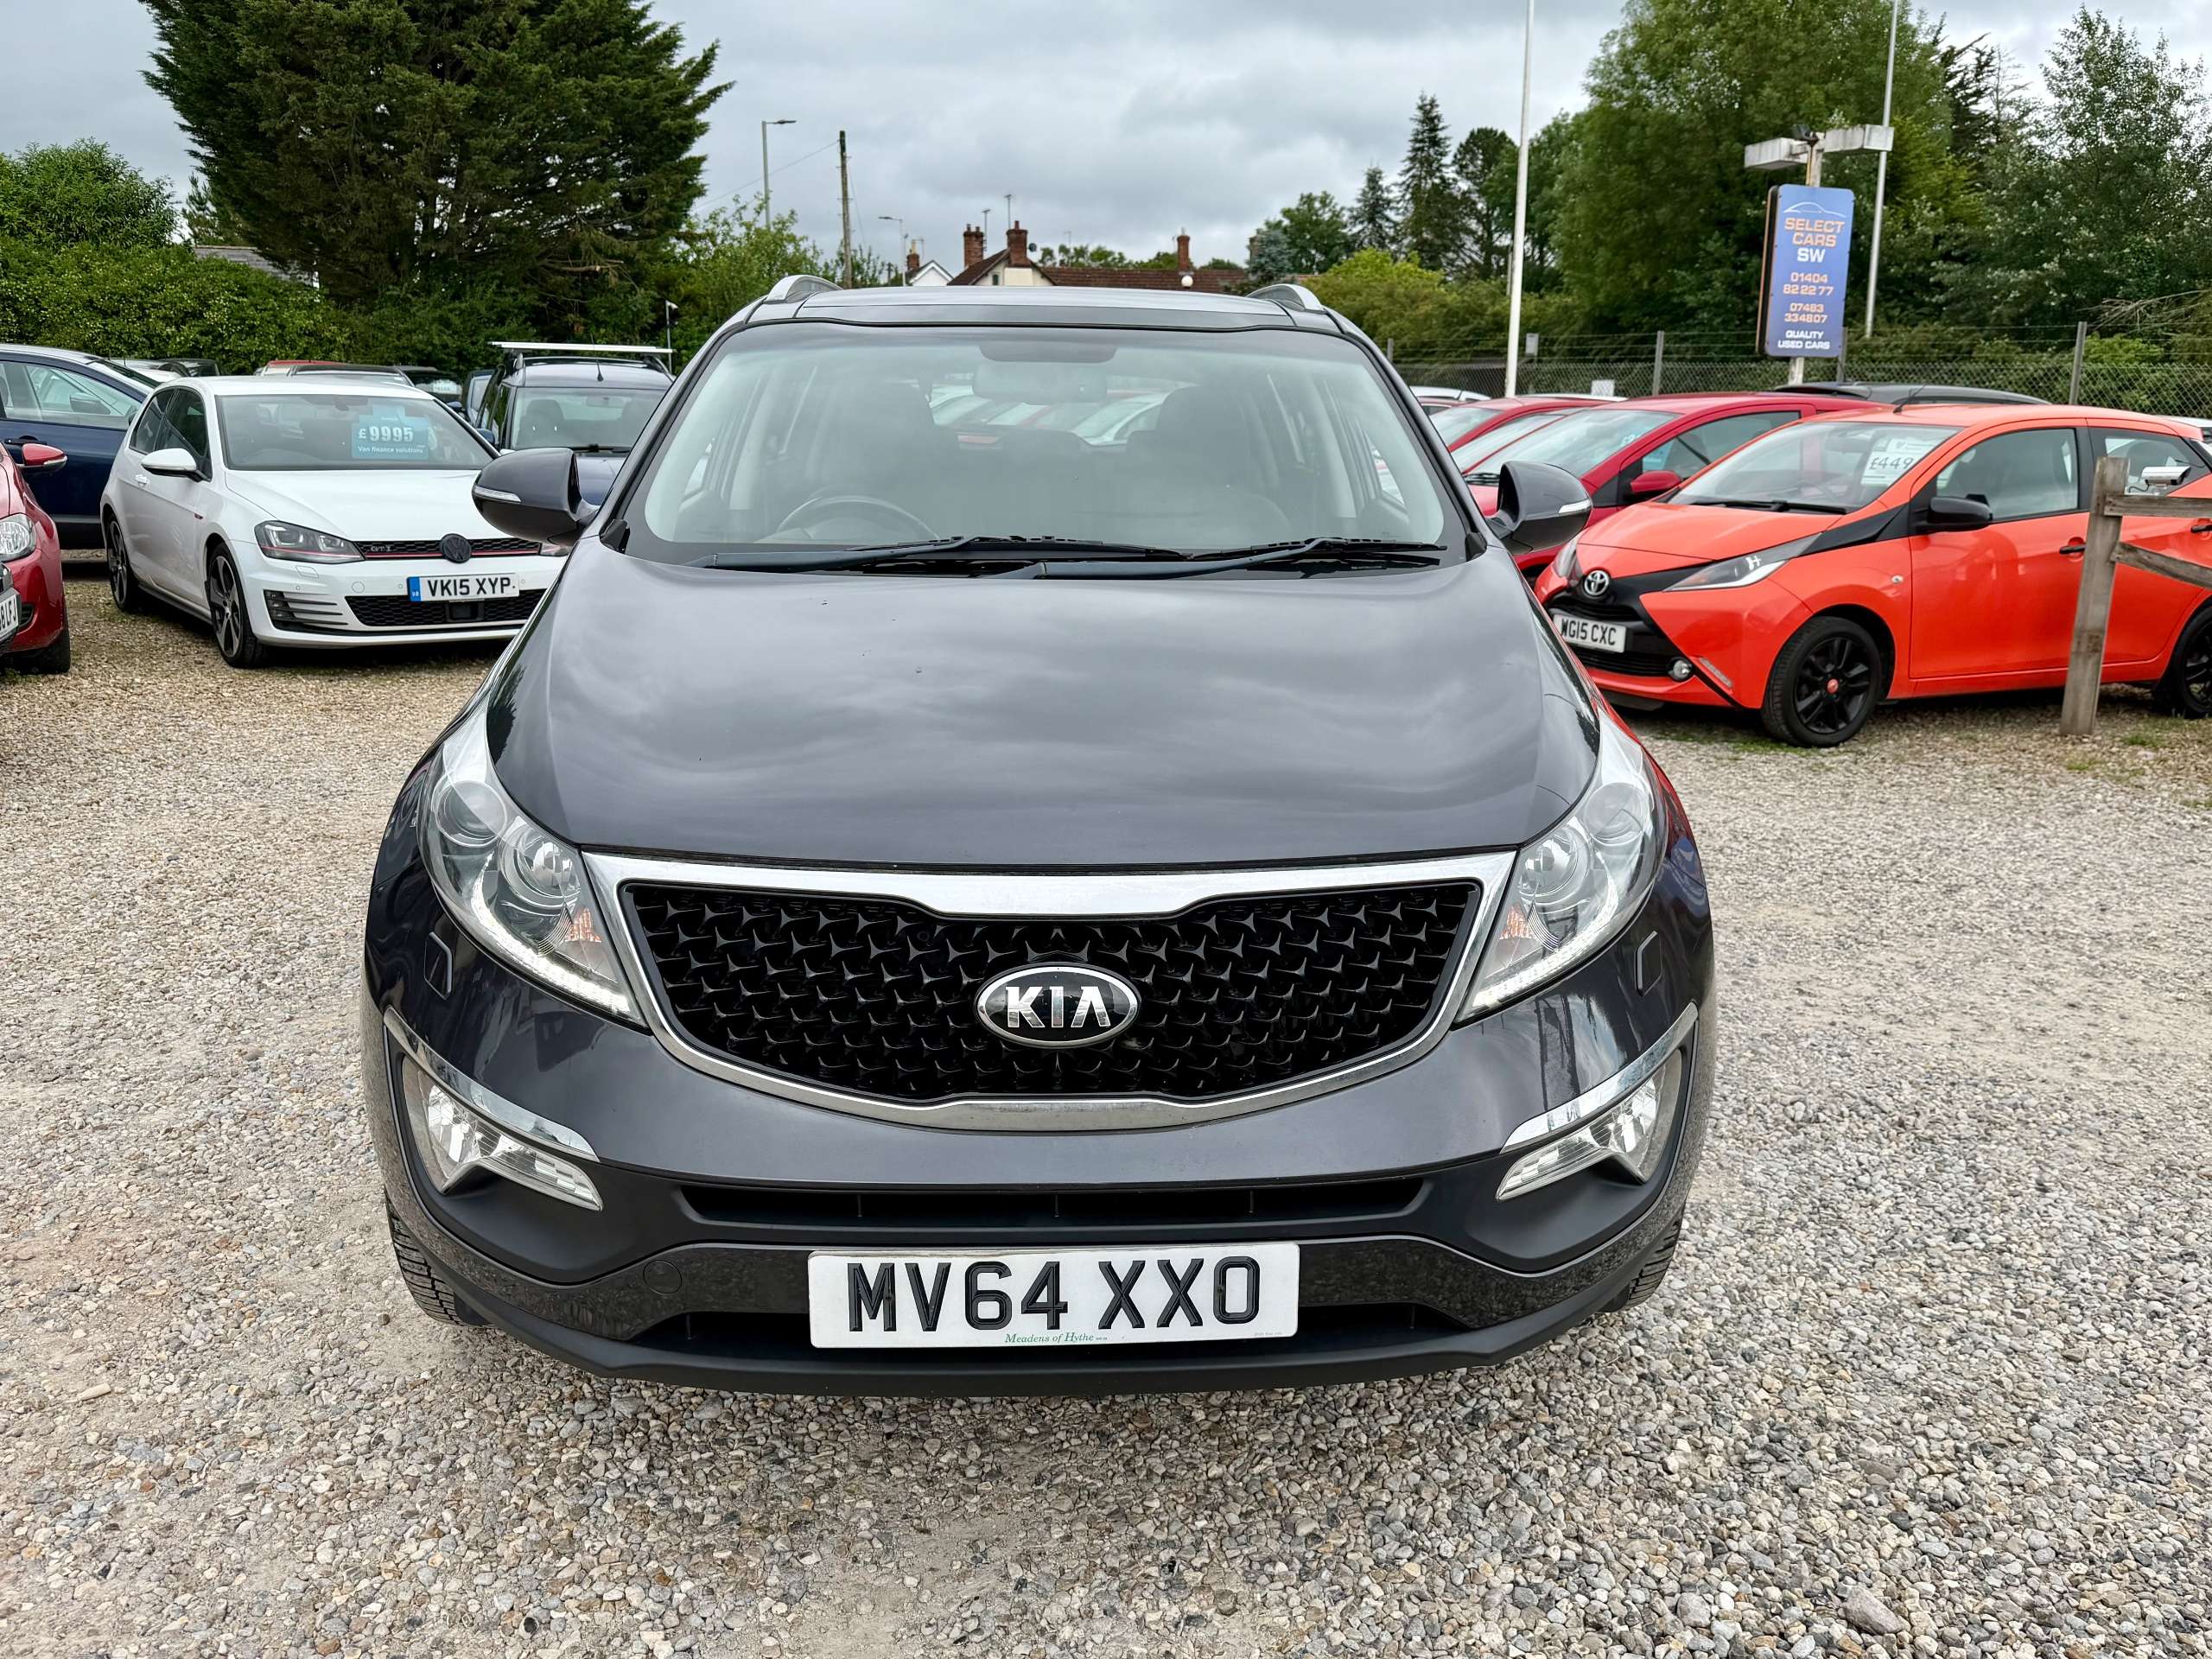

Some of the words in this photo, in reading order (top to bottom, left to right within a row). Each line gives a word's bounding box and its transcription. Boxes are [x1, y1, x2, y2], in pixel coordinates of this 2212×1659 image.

[1784, 217, 1845, 233] SELECT
[1792, 232, 1837, 247] CARS
[1796, 247, 1826, 263] SW
[1790, 271, 1828, 283] 01404
[1785, 330, 1824, 339] QUALITY
[1777, 340, 1803, 349] USED
[1804, 340, 1830, 350] CARS
[428, 579, 470, 597] VK15
[476, 576, 512, 595] XYP
[1561, 618, 1588, 640] WG15
[1591, 624, 1617, 646] CXC
[1006, 986, 1111, 1028] KIA
[847, 1261, 1068, 1332] MV64
[1097, 1255, 1261, 1329] XXO
[1005, 1333, 1050, 1343] Meadens
[1052, 1333, 1064, 1344] of
[1064, 1332, 1094, 1343] Hythe
